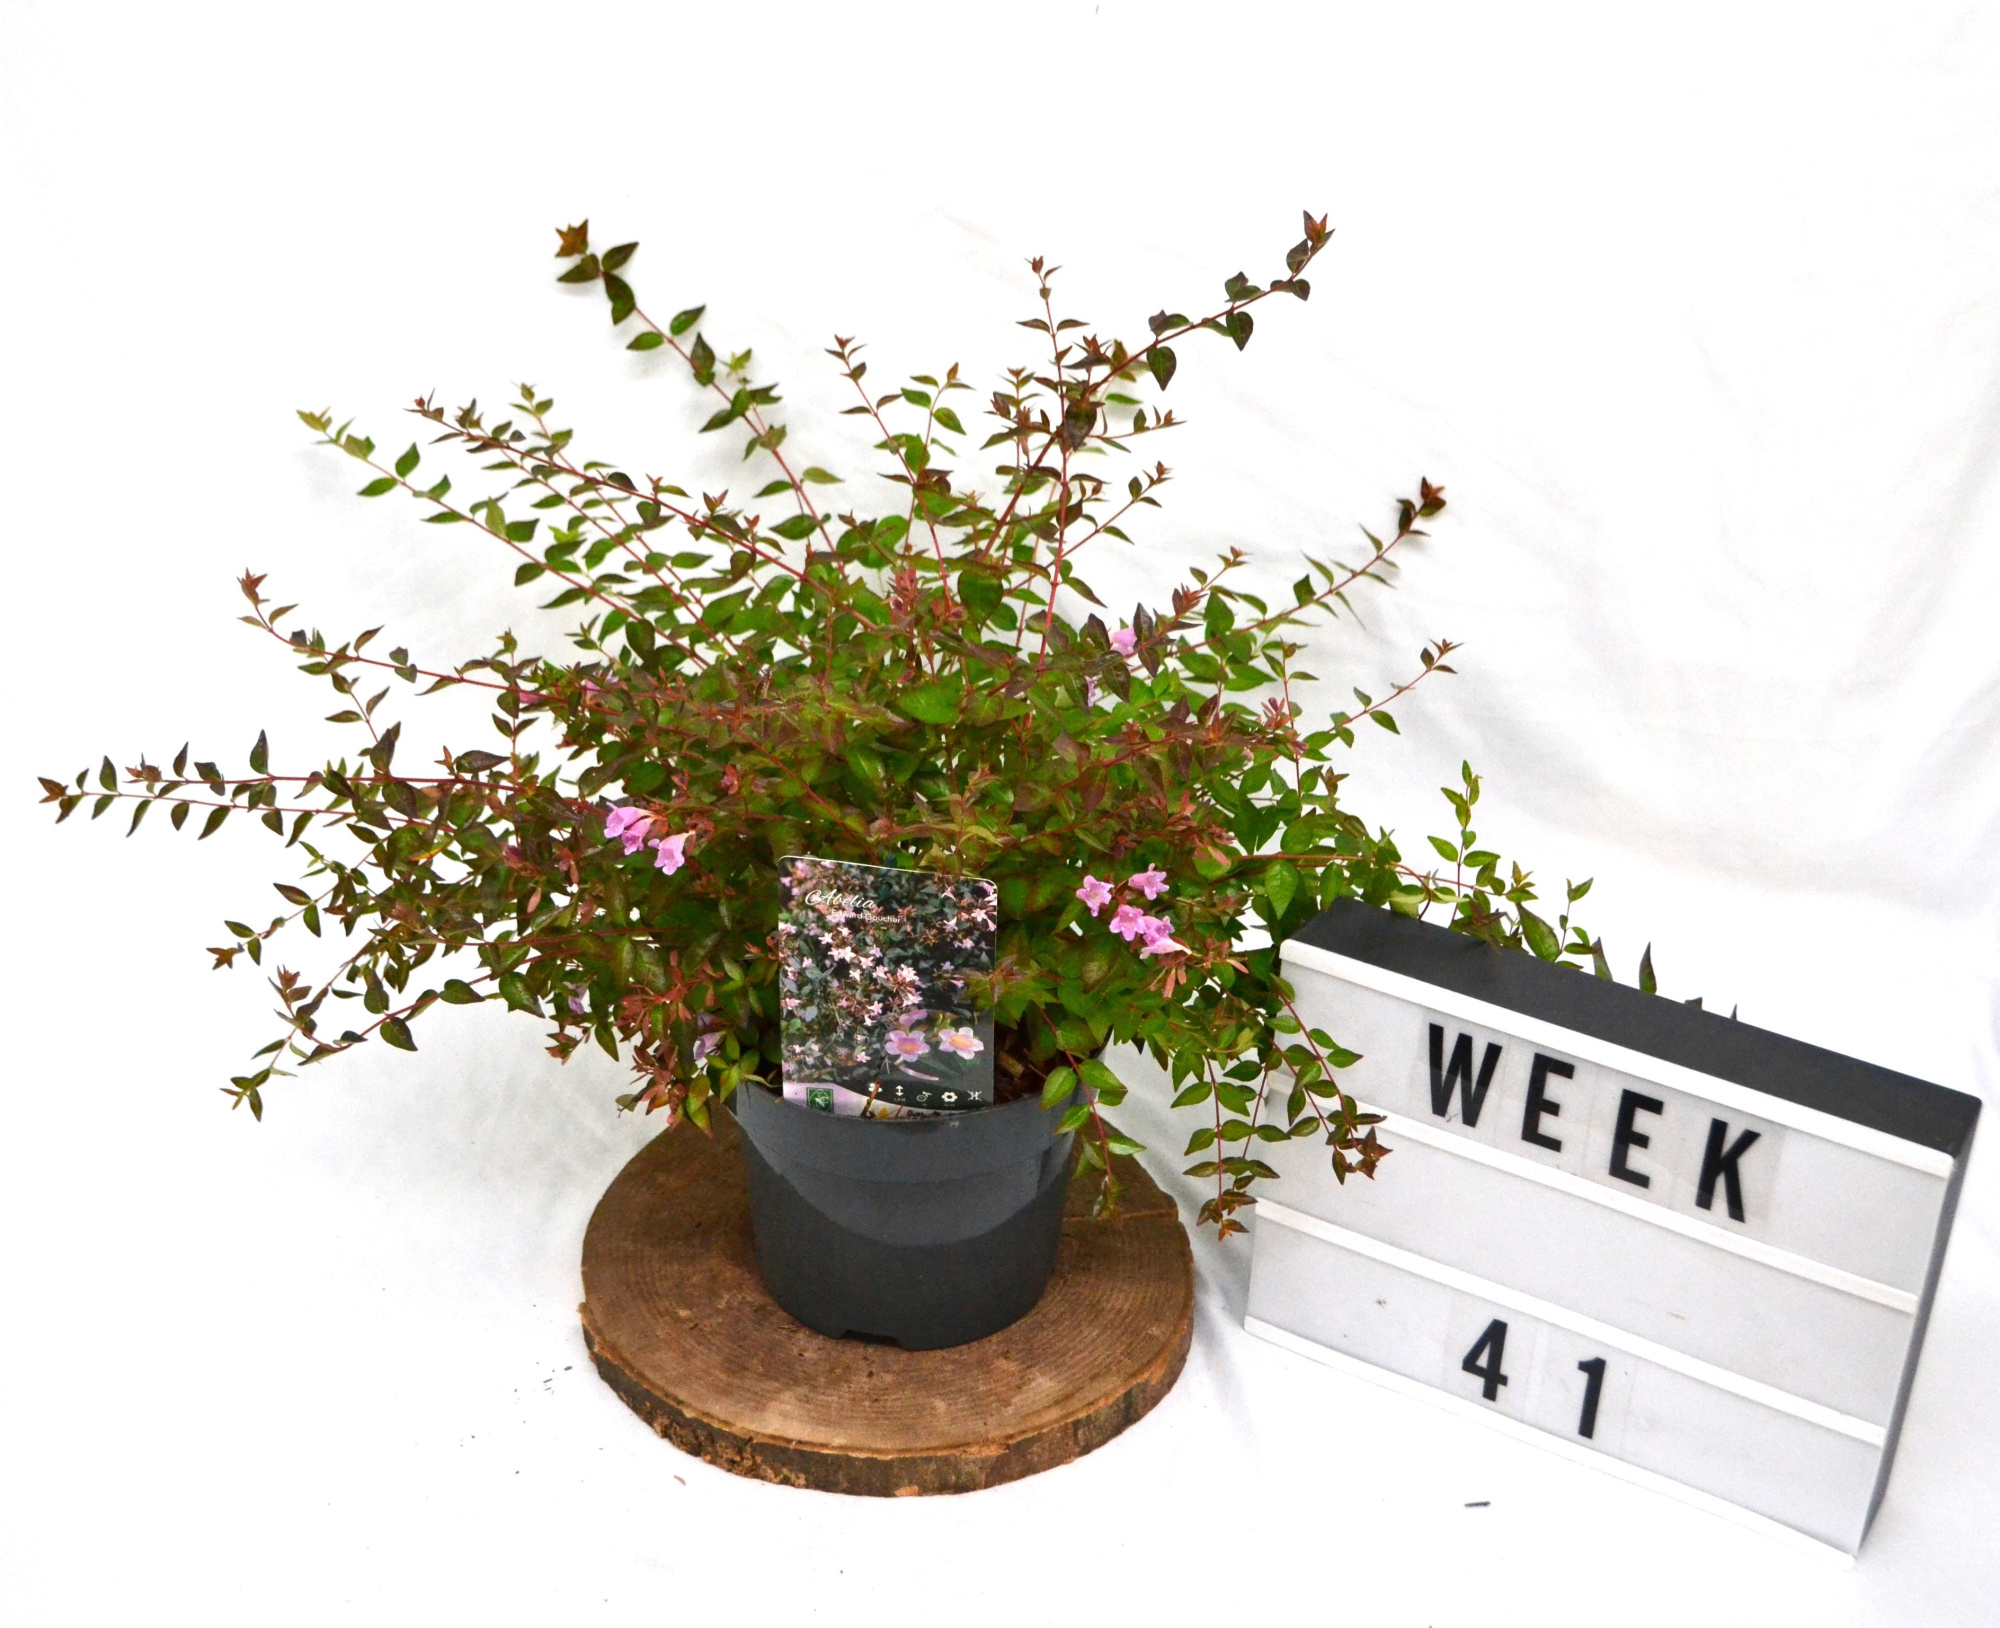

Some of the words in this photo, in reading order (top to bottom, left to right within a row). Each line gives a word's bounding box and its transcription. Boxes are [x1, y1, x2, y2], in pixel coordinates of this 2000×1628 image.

[804, 888, 875, 909] Abelia
[1429, 1022, 1761, 1223] WEEK
[1461, 1318, 1607, 1440] 41
